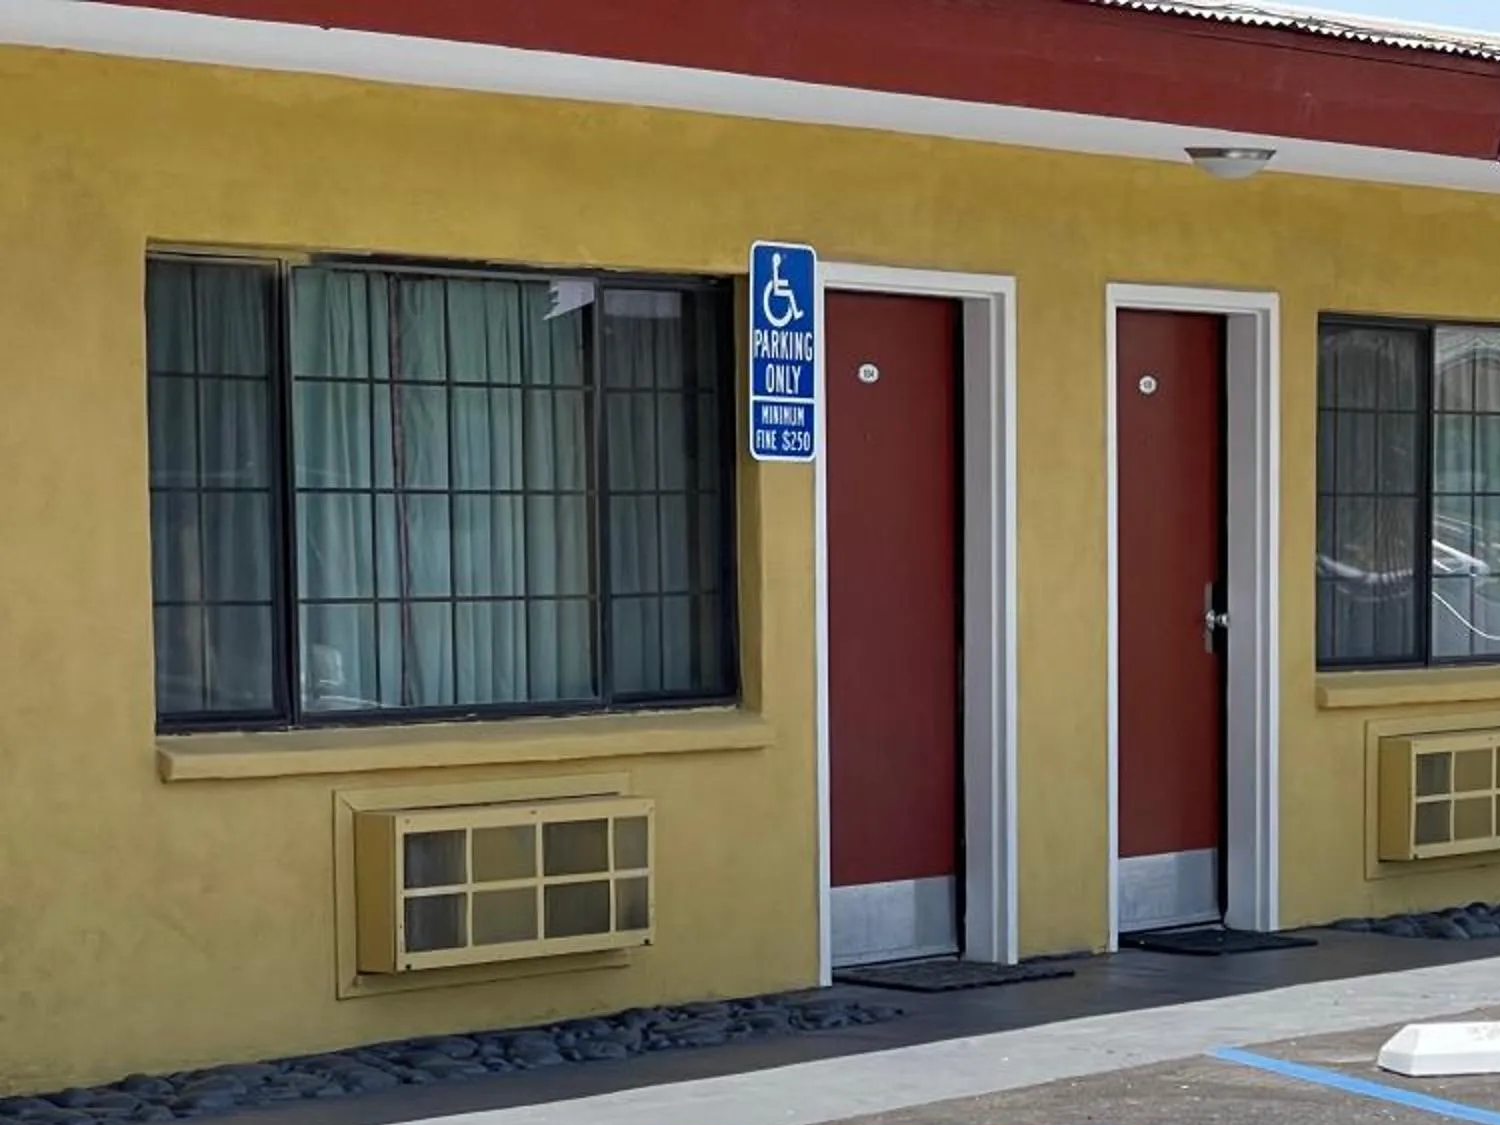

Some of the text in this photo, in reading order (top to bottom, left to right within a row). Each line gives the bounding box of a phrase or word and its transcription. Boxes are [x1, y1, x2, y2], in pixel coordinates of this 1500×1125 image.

[754, 329, 813, 361] PARKING
[765, 363, 801, 394] ONLY
[761, 405, 805, 426] MINIMUM
[756, 429, 811, 451] FINE $250
